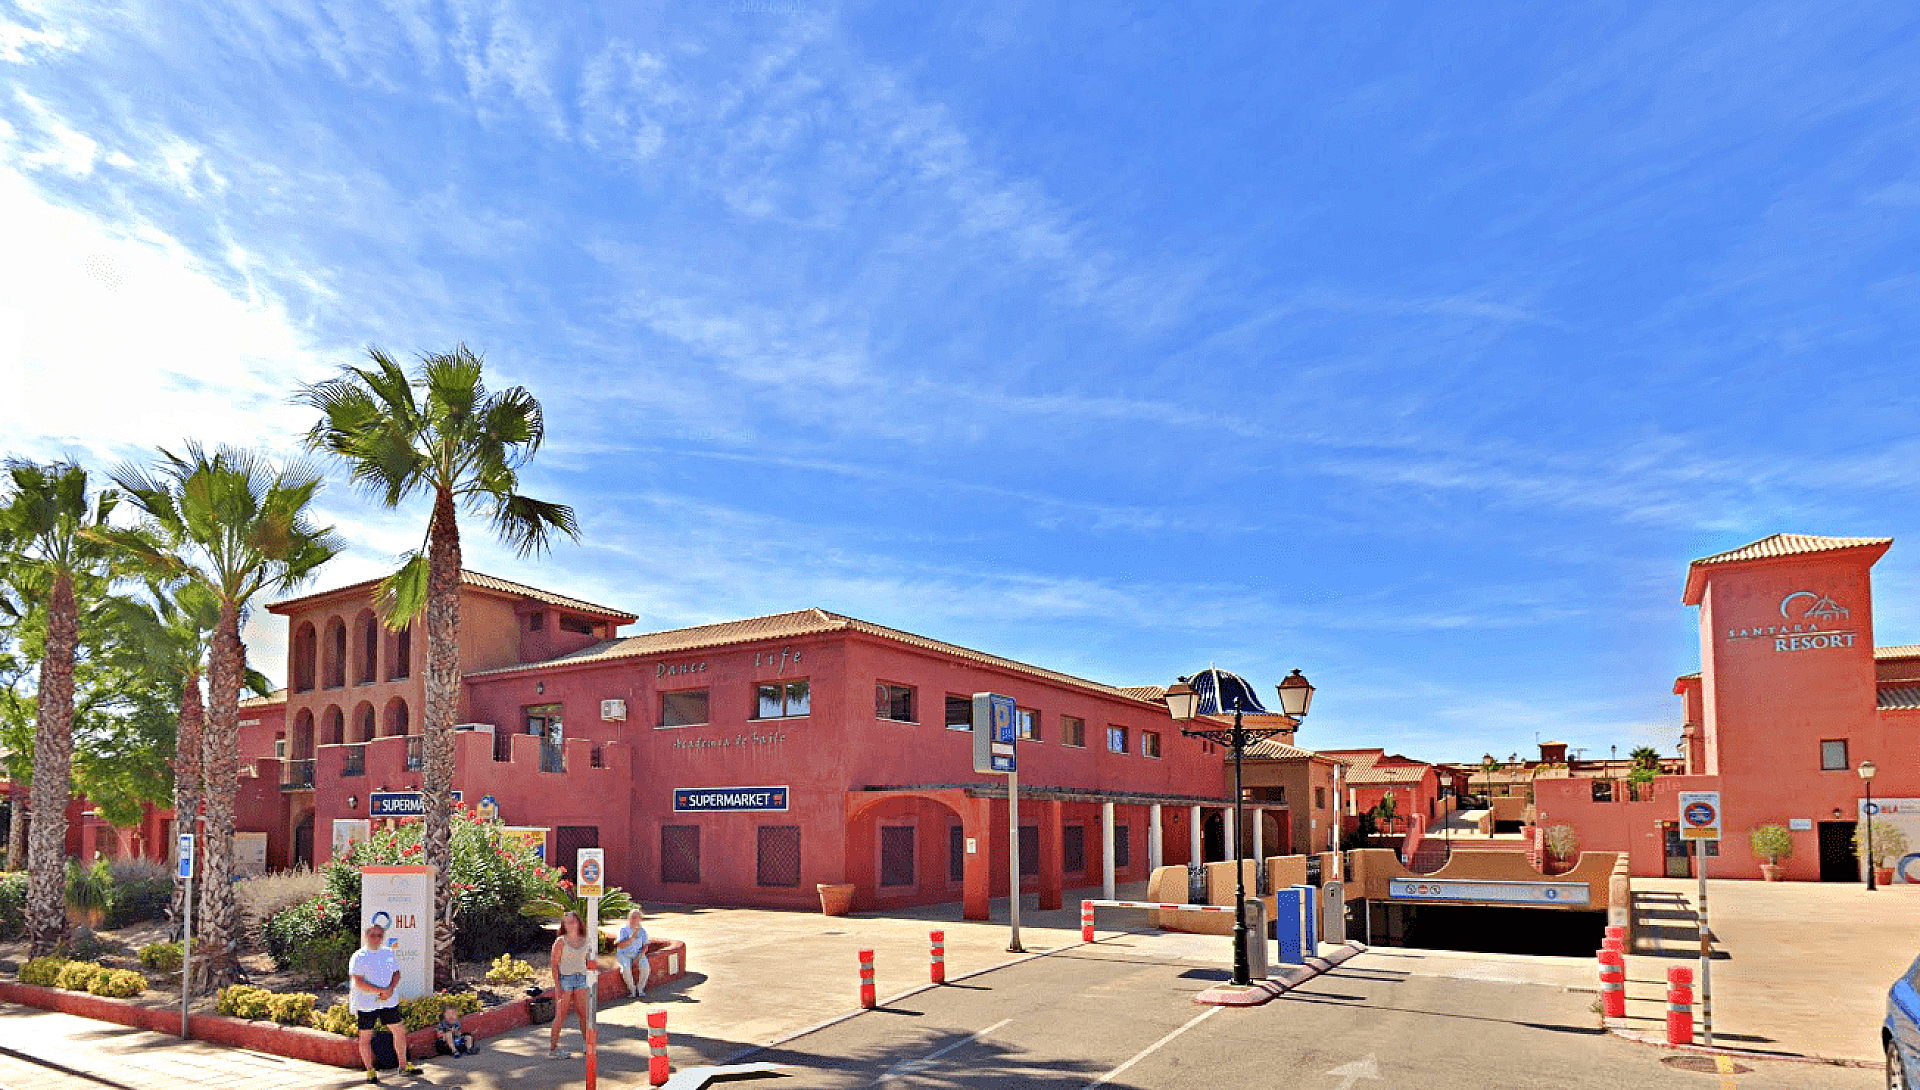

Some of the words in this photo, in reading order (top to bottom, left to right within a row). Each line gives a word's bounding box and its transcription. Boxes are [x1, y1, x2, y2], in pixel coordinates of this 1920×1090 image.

[1729, 624, 1817, 637] SANTARA
[1775, 634, 1856, 652] RESORT
[657, 662, 707, 680] Dance
[382, 799, 425, 812] SUPERMA
[689, 793, 771, 807] SUPERMARKET
[395, 915, 416, 928] HLA
